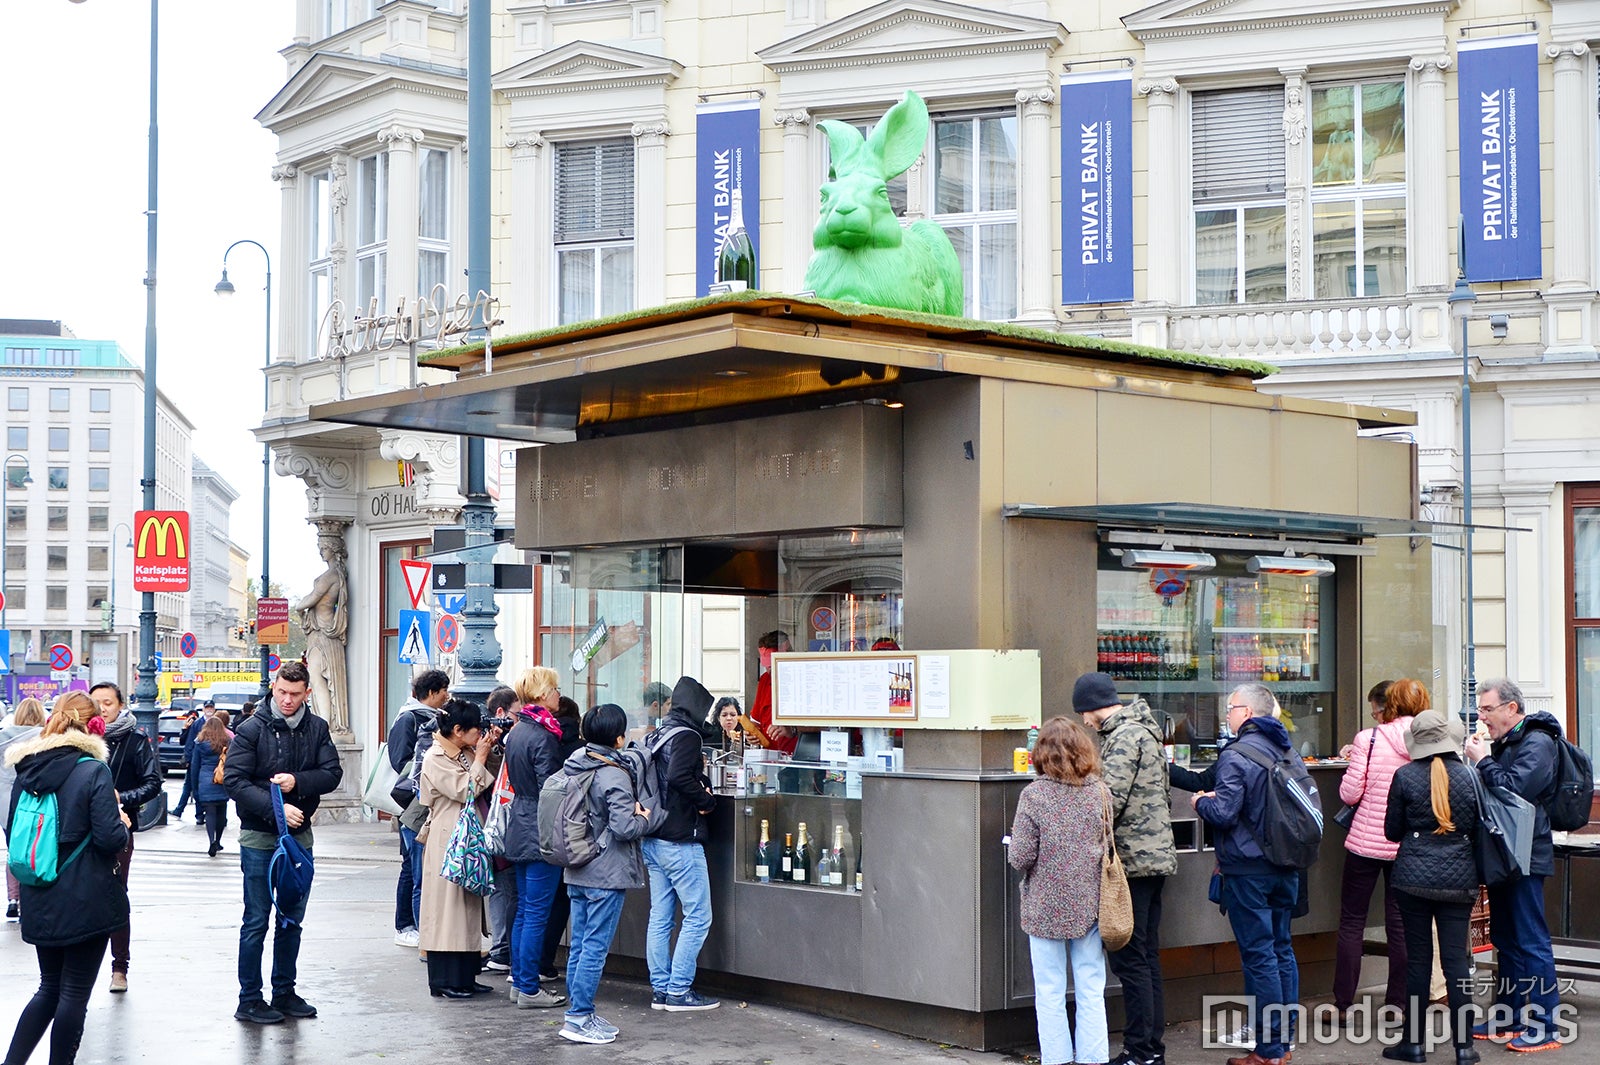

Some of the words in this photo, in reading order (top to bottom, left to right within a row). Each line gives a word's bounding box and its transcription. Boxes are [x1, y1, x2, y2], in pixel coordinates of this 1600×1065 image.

[1481, 89, 1500, 155] BANK
[1508, 87, 1516, 144] Oberösterreich
[1081, 121, 1098, 182] BANK
[1104, 120, 1112, 173] Oberösterreich
[713, 149, 729, 206] BANK
[1482, 160, 1502, 241] PRIVAT
[1509, 145, 1518, 226] Raiffeisenlandesbank
[1081, 188, 1099, 265] PRIVAT
[1105, 174, 1113, 249] Raiffeisenlandesbank
[1510, 227, 1518, 239] der
[371, 492, 390, 516] OÖ
[393, 494, 419, 514] HAU
[135, 565, 187, 576] Karlsplatz
[160, 576, 187, 584] Passage
[19, 682, 58, 690] BOHEIAN
